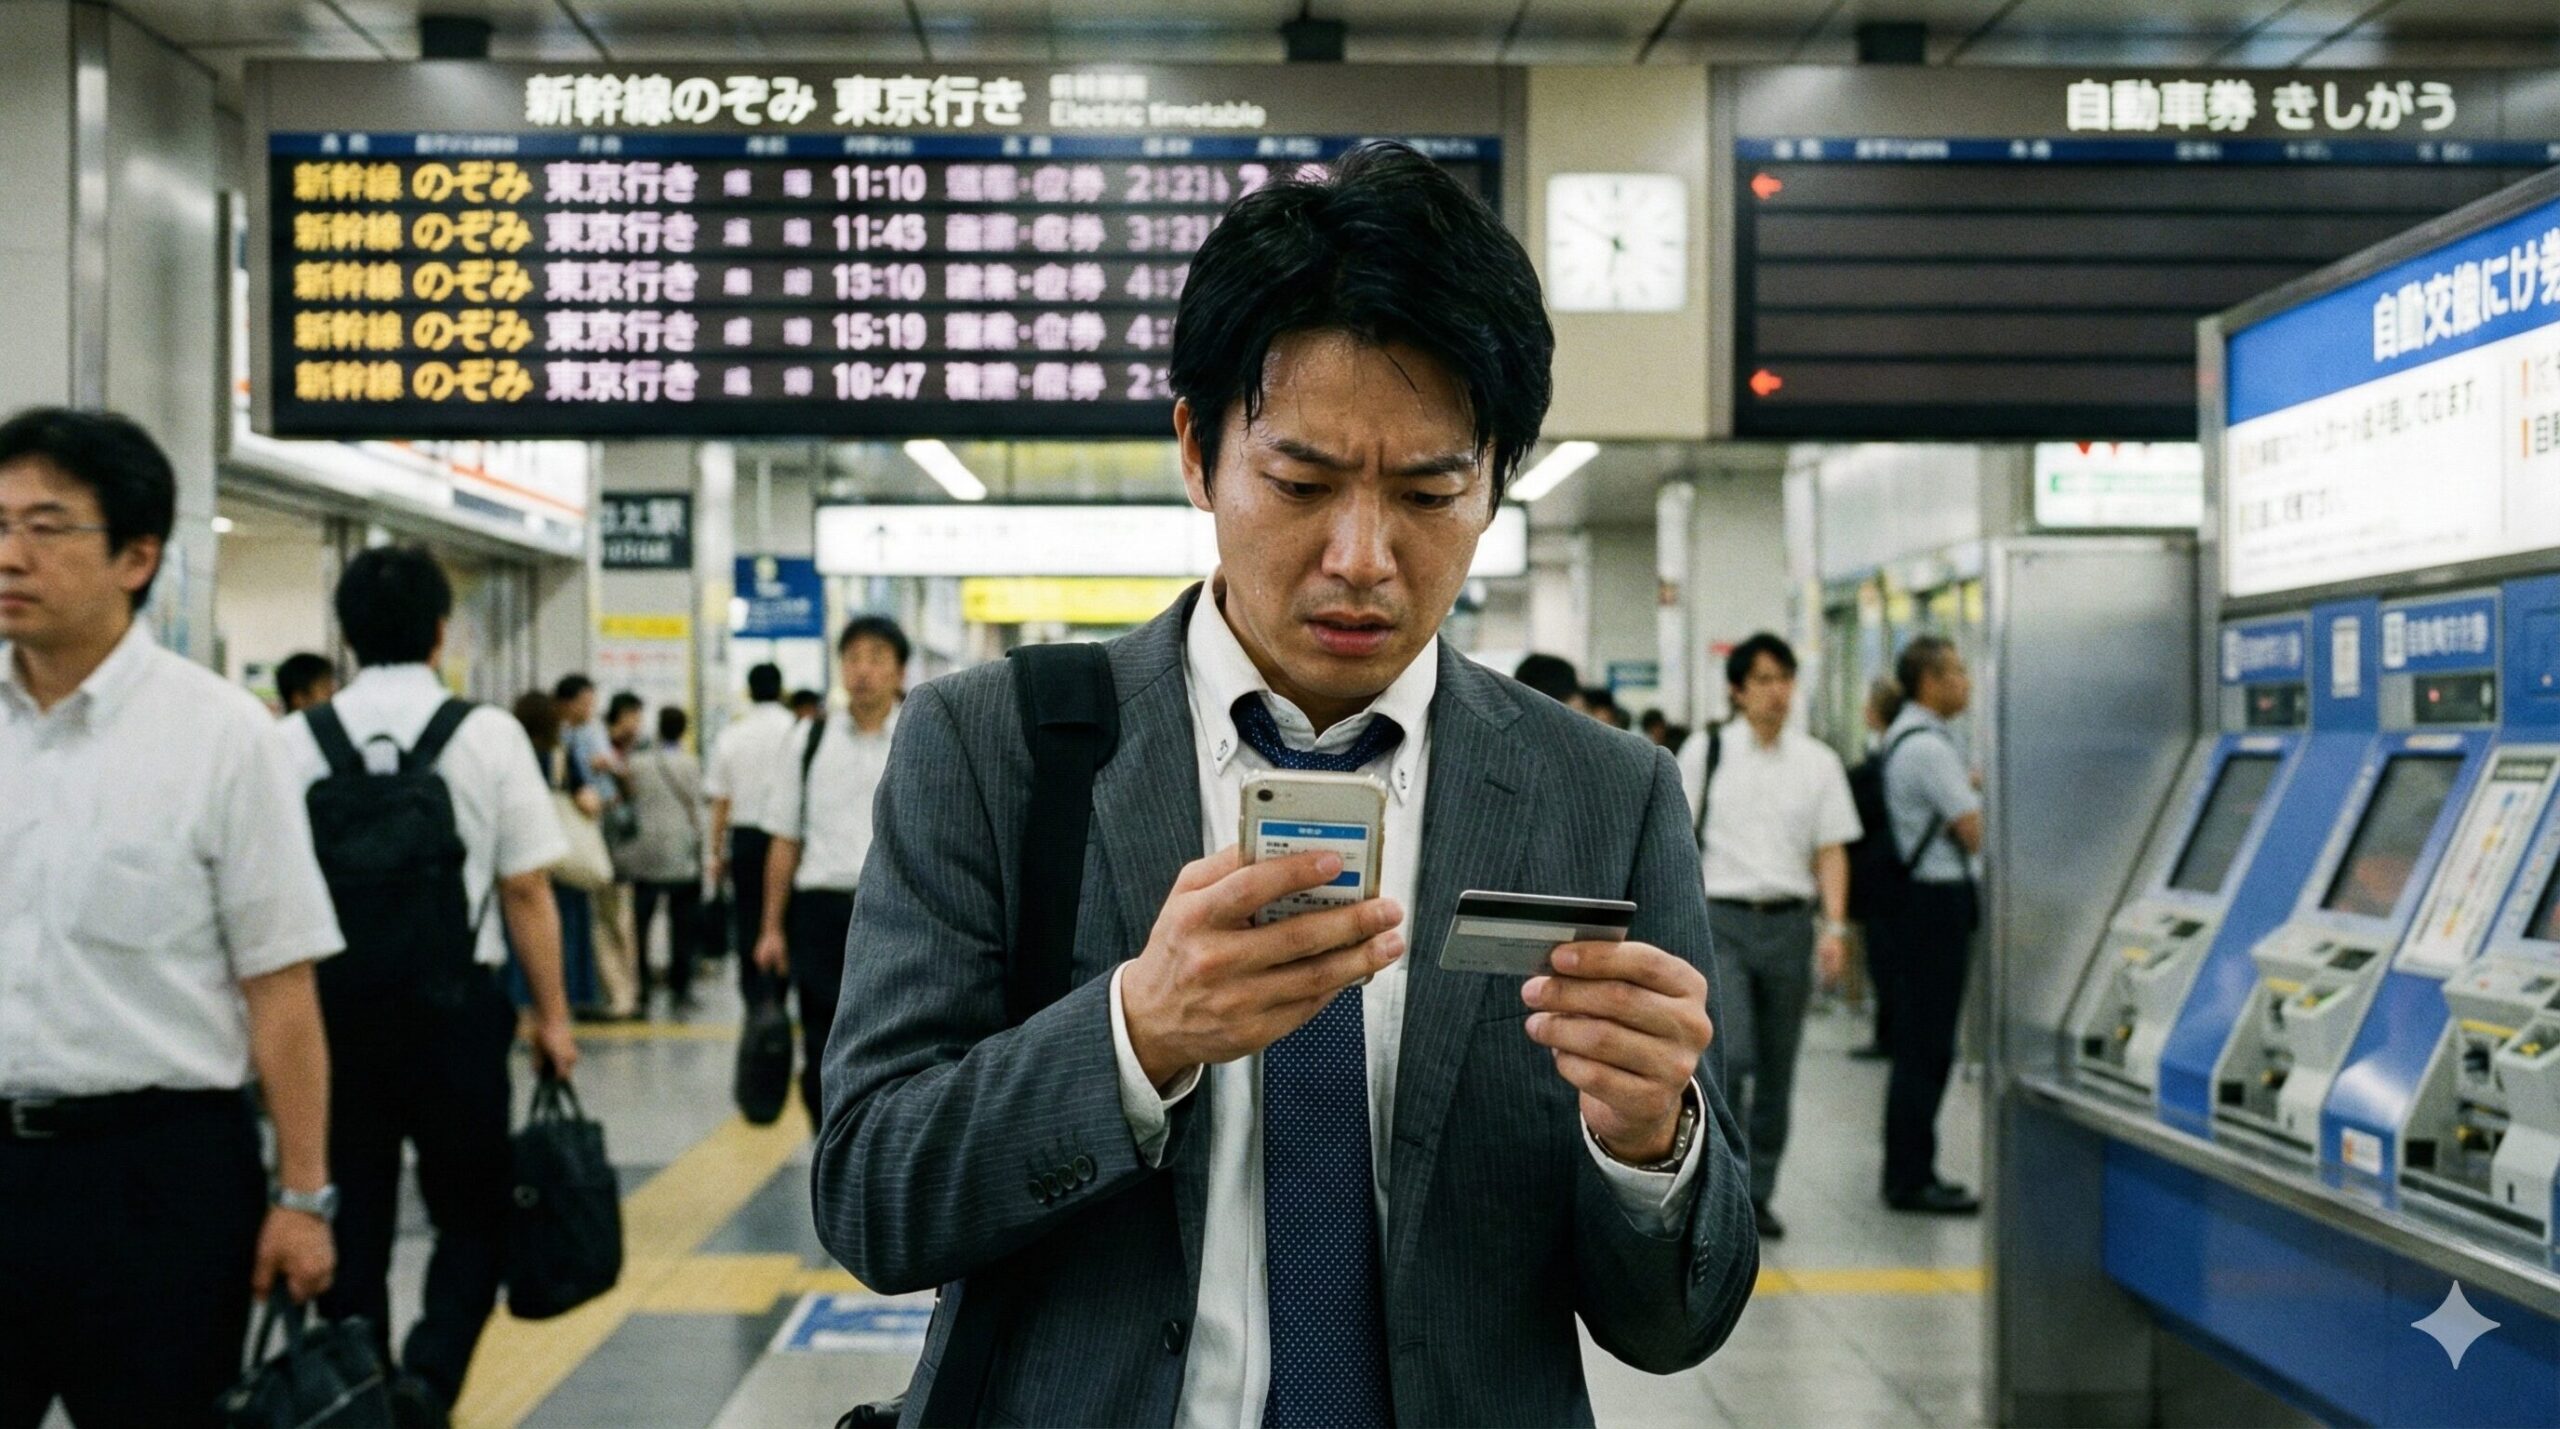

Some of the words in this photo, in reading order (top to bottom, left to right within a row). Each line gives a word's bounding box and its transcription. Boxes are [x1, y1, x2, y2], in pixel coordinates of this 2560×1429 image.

[526, 75, 816, 125] 新幹線のぞみ
[834, 76, 1025, 126] 東京行き
[2067, 79, 2256, 131] 自動車券
[2273, 81, 2457, 131] きしがう
[412, 161, 533, 203] のぞみ
[545, 161, 698, 203] 東京行き
[832, 164, 927, 202] 11:10
[412, 211, 533, 253] のぞみ
[545, 211, 698, 253] 東京行き
[832, 214, 927, 252] 11:43
[412, 260, 533, 302] のぞみ
[545, 260, 698, 302] 東京行き
[412, 310, 533, 352] のぞみ
[545, 310, 698, 352] 東京行き
[412, 360, 533, 401] のぞみ
[545, 360, 698, 401] 東京行き
[832, 363, 927, 400] 10:47
